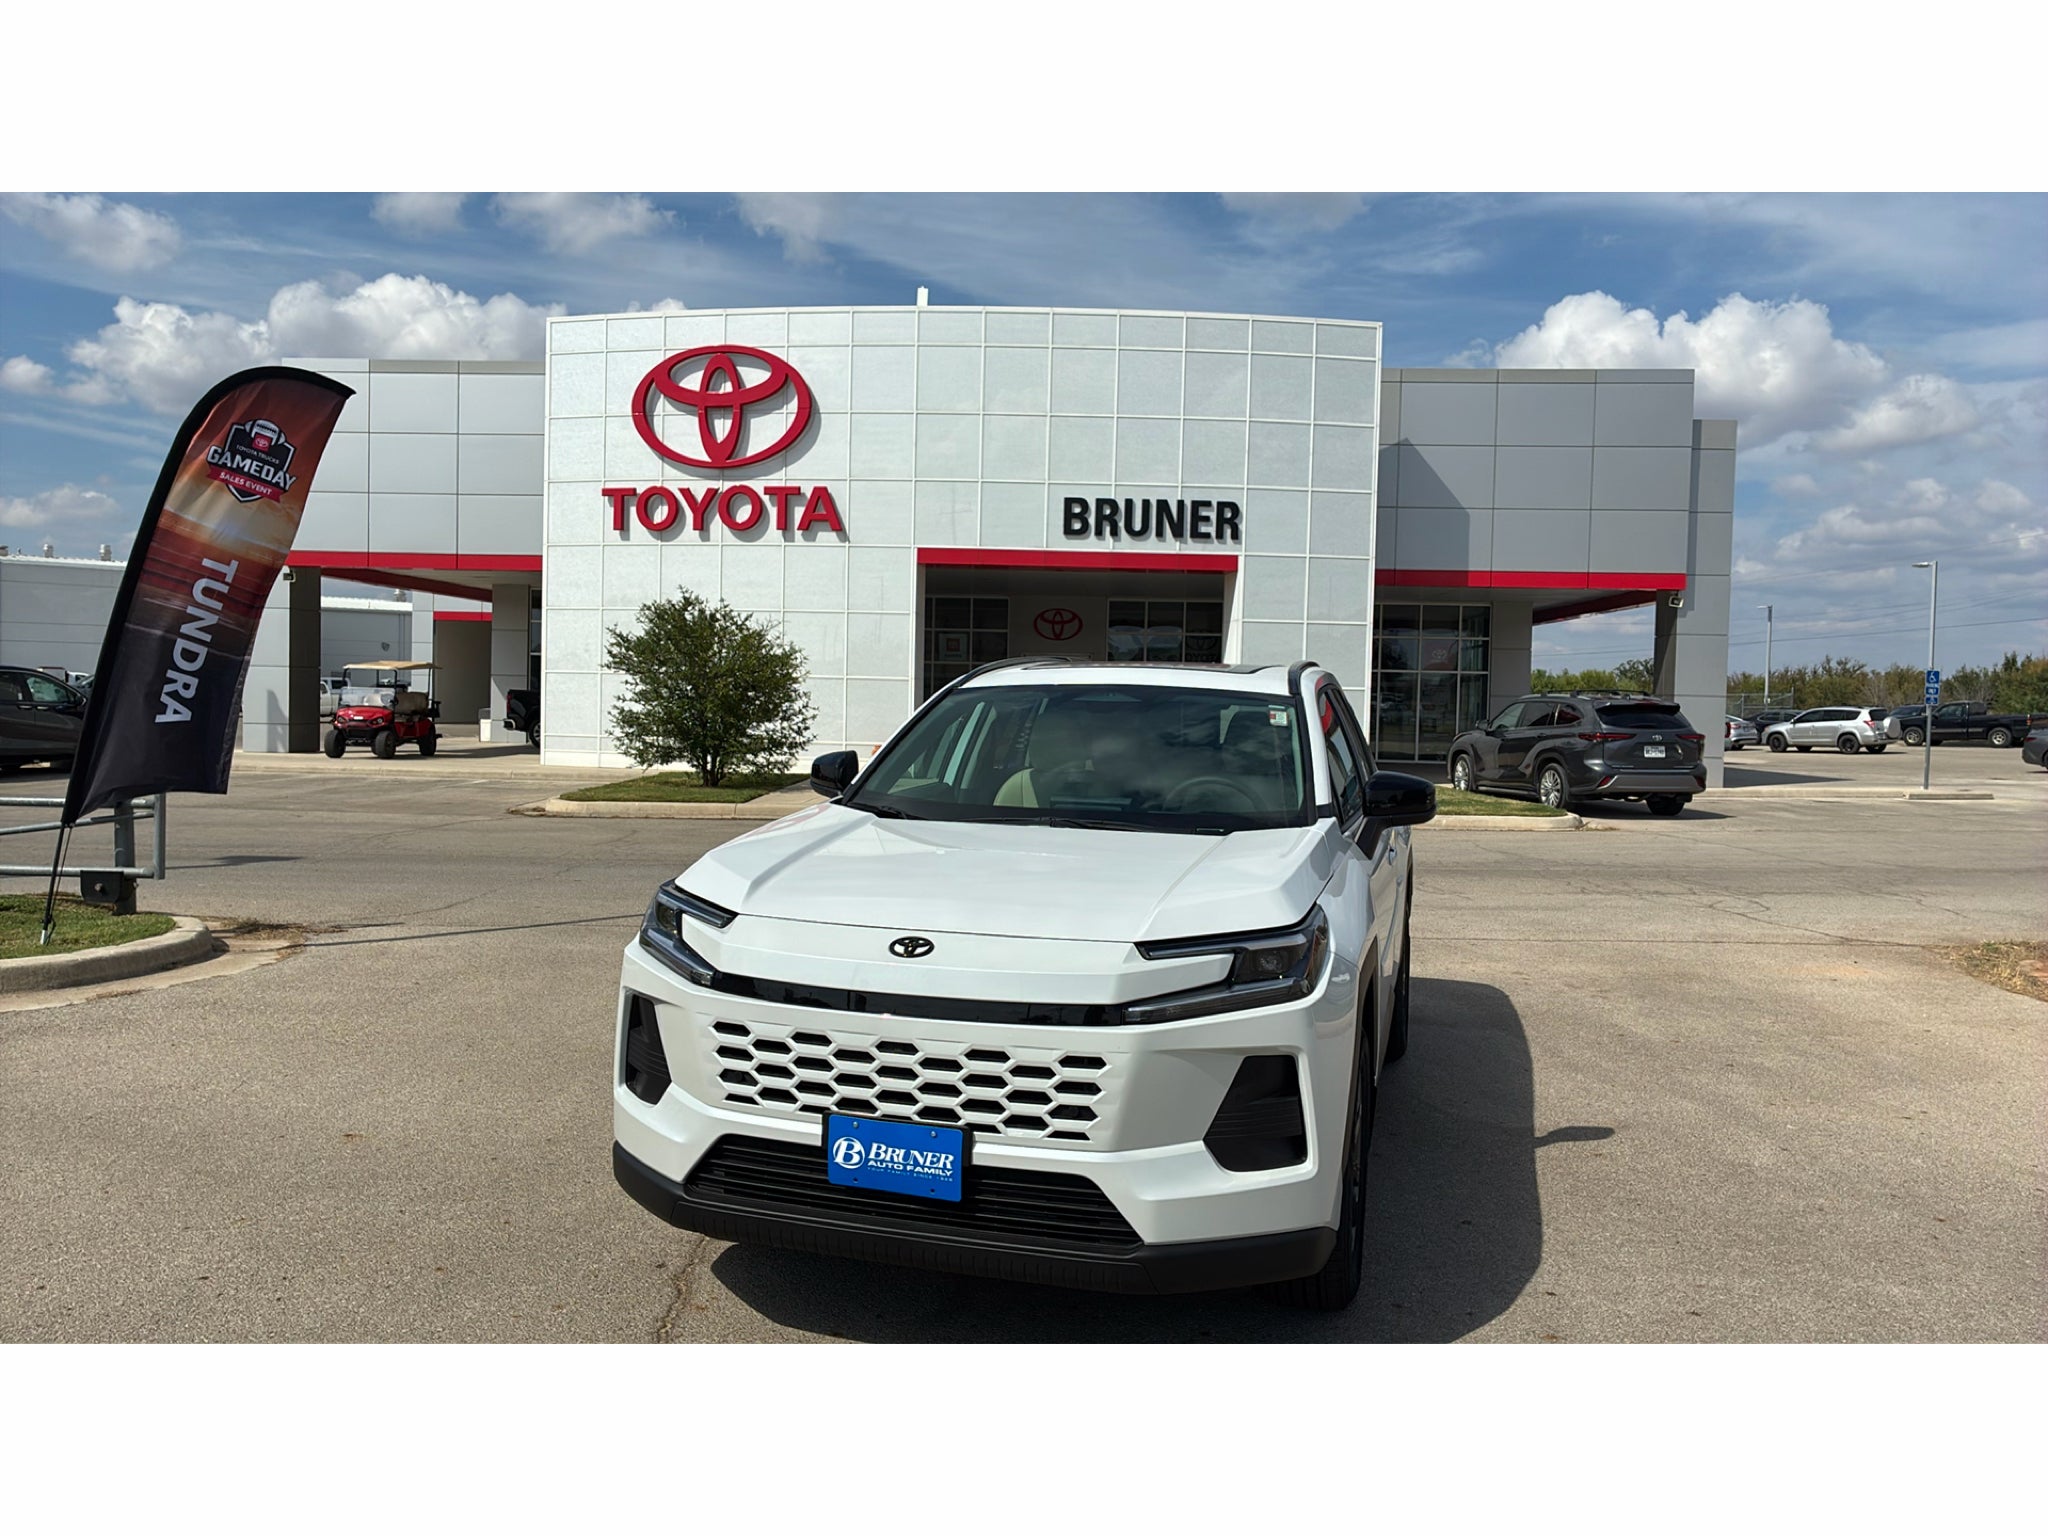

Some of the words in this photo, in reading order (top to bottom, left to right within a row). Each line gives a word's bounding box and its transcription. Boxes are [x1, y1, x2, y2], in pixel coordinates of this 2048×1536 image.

[207, 445, 296, 491] GAMEDAY
[219, 471, 244, 485] SALES
[246, 480, 272, 495] EVENT
[602, 485, 843, 531] TOYOTA
[1063, 497, 1240, 540] BRUNER
[155, 558, 239, 723] TUNDRA
[867, 1160, 904, 1171] AUTO
[906, 1165, 953, 1177] FAMILY
[868, 1142, 954, 1169] BRUNER
